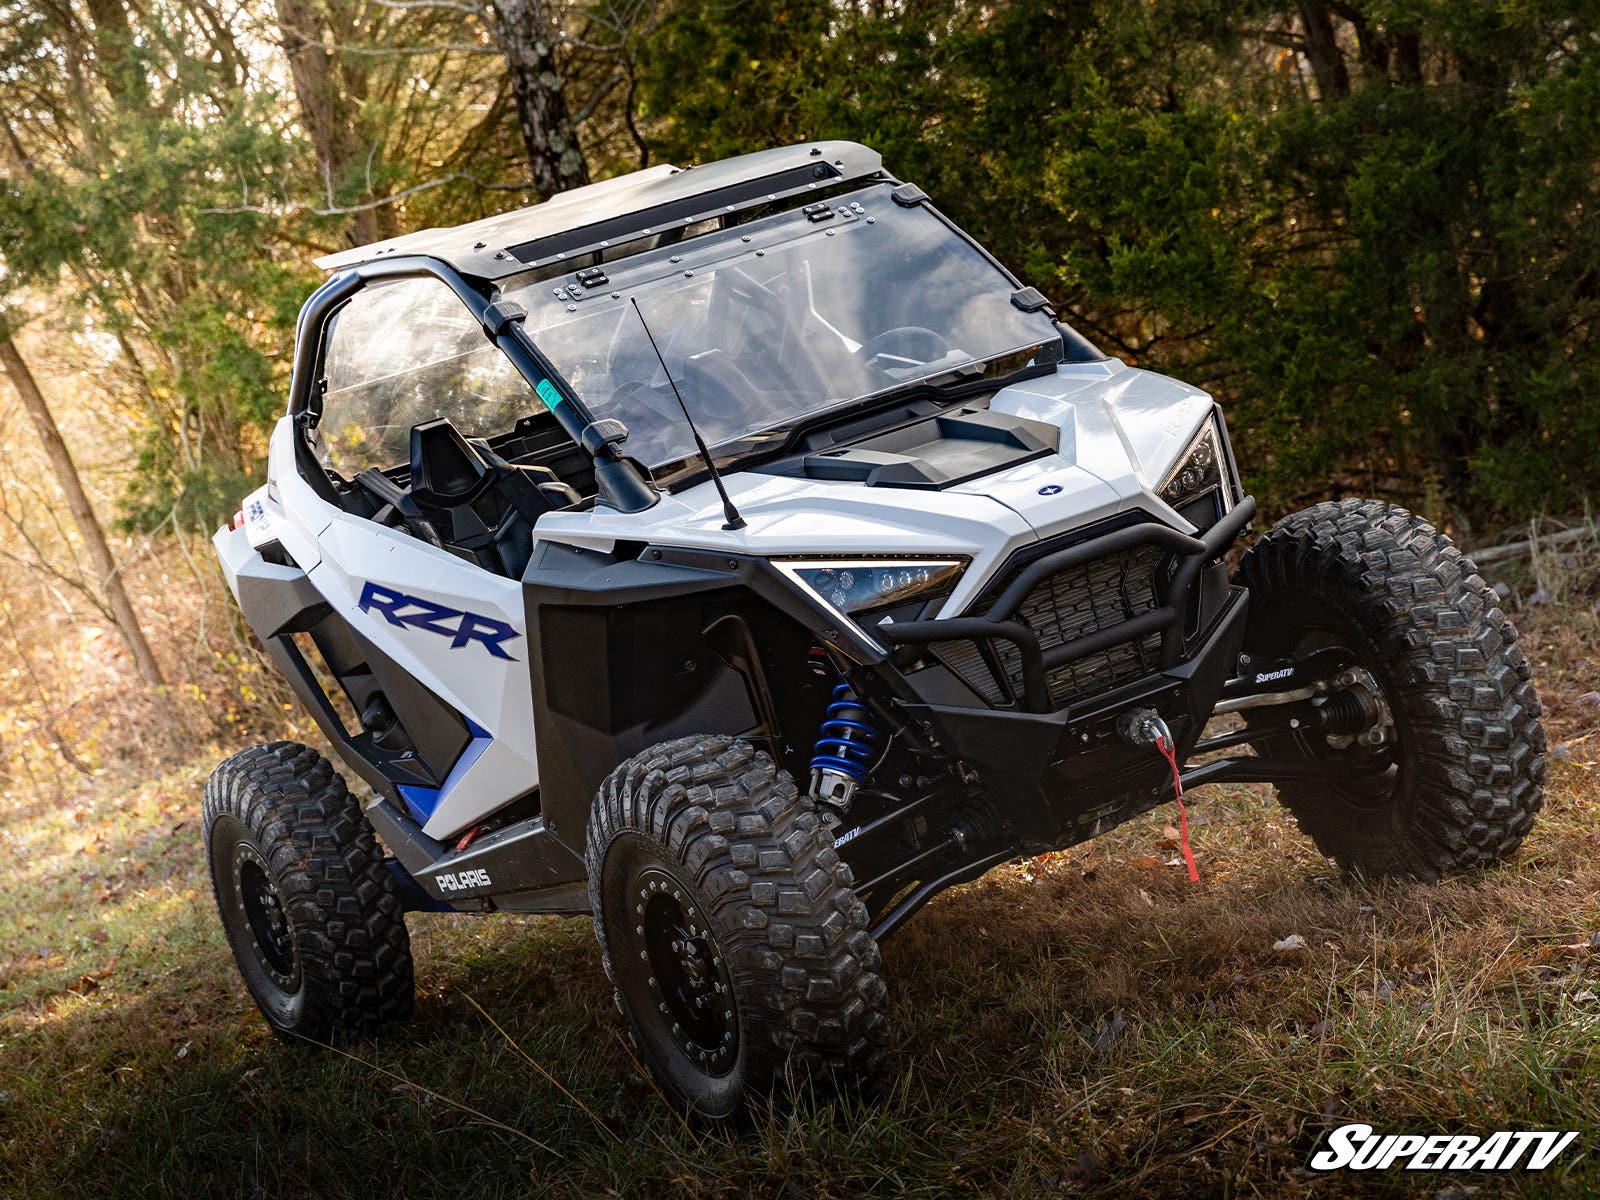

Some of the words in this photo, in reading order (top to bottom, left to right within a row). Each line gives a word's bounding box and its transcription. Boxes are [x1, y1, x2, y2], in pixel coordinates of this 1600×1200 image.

[358, 580, 522, 662] RZR
[1255, 668, 1293, 683] SUPERATV
[834, 826, 861, 849] ERATV
[435, 868, 491, 892] POLARIS
